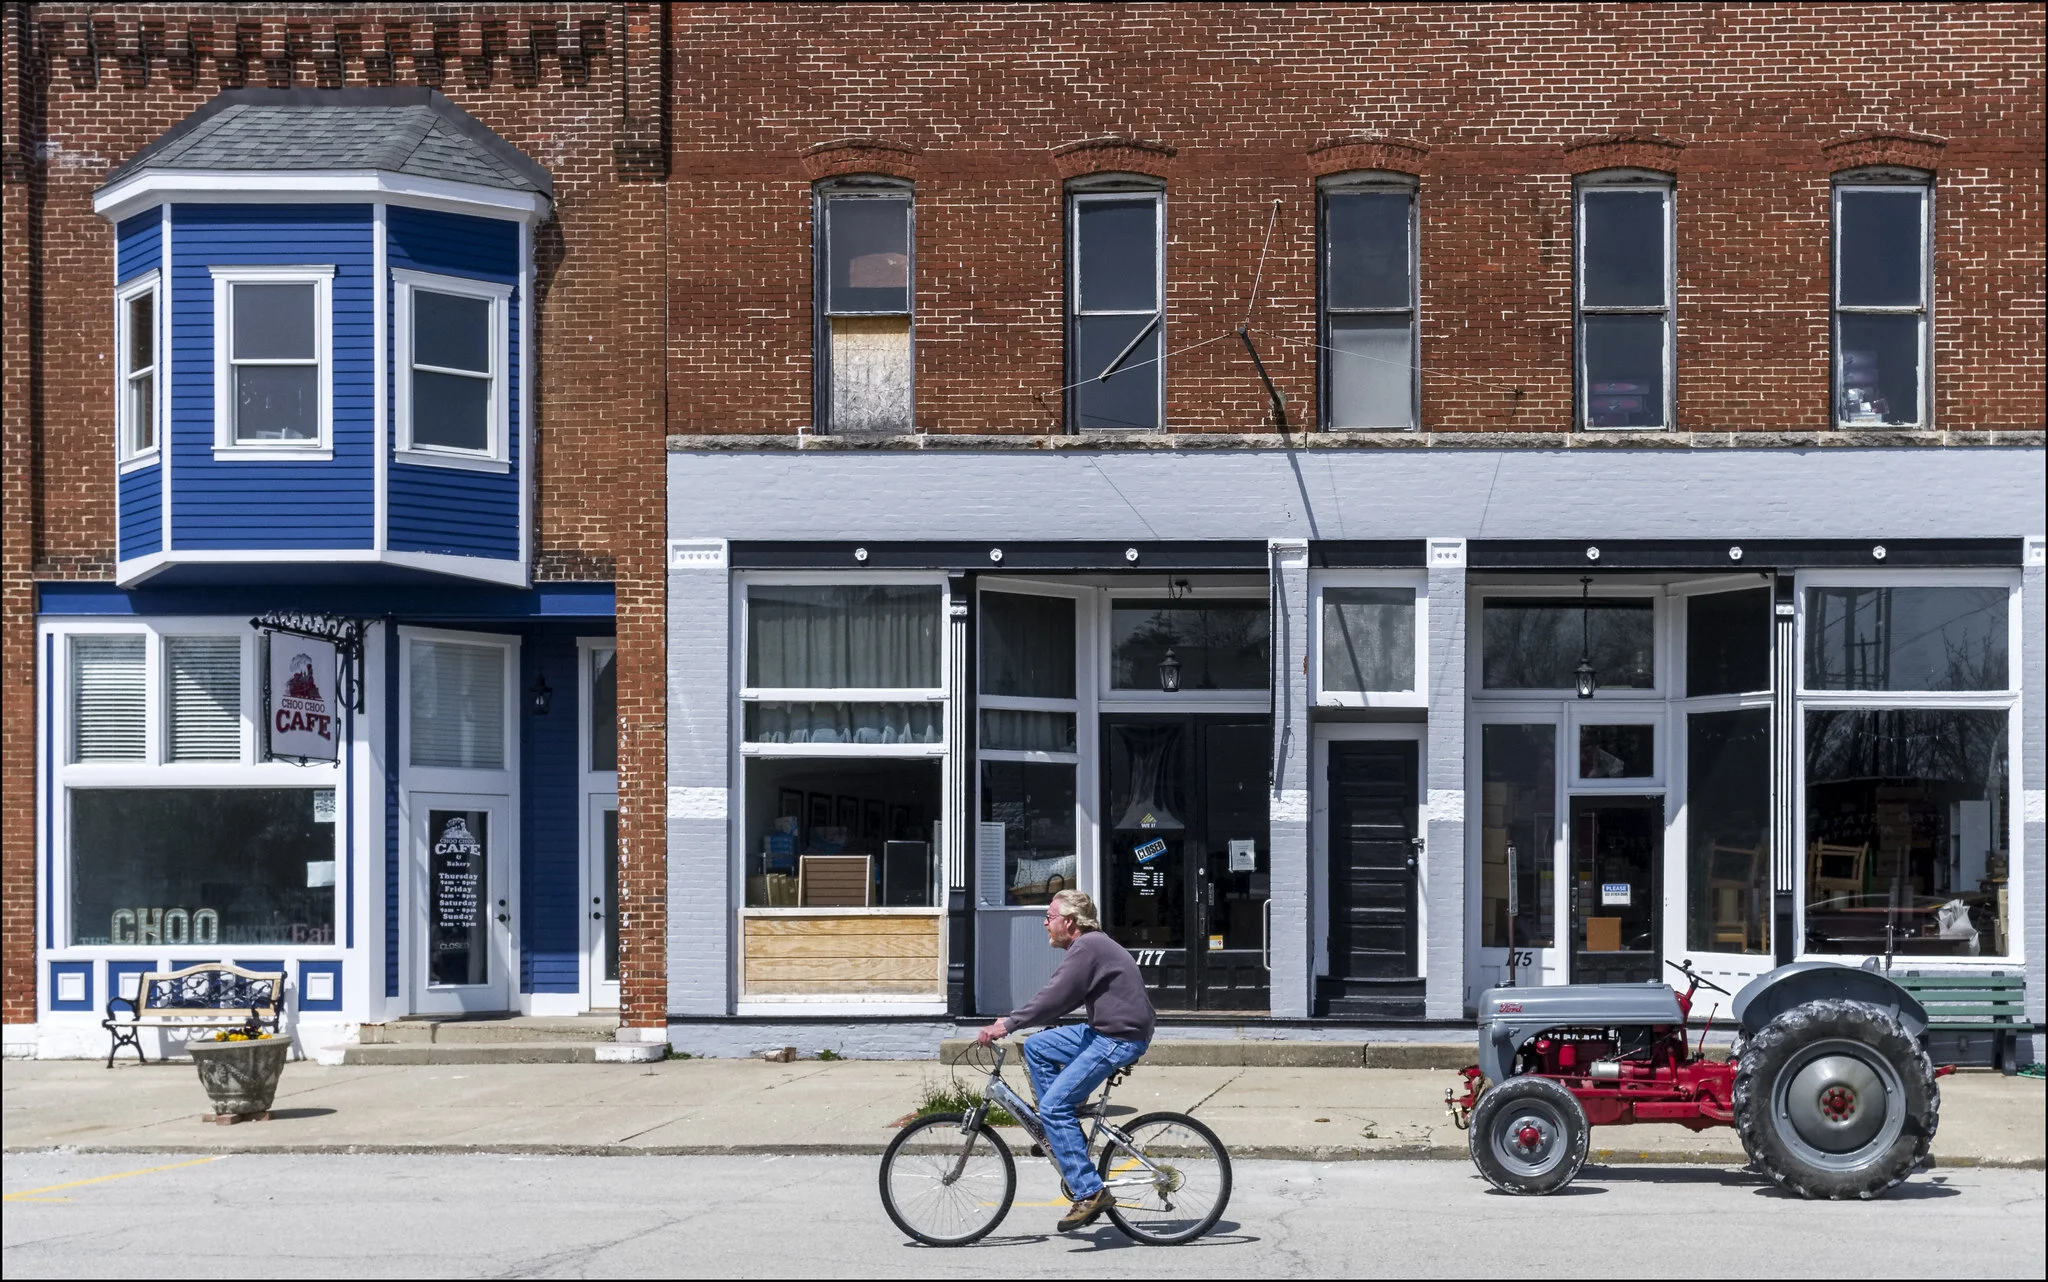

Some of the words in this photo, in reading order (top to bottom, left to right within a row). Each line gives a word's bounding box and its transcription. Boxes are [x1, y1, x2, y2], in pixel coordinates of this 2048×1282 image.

[282, 699, 303, 710] CHOO
[305, 701, 325, 713] CHOO
[276, 709, 331, 740] CAFE
[435, 843, 481, 856] CAFE
[1137, 840, 1164, 860] CLOSED
[438, 872, 478, 881] Thursday
[111, 908, 218, 945] CHOO
[291, 923, 331, 945] Eat
[1136, 950, 1166, 966] 177
[1499, 1003, 1523, 1013] Ford
[1015, 1107, 1052, 1151] MONGOOSE
